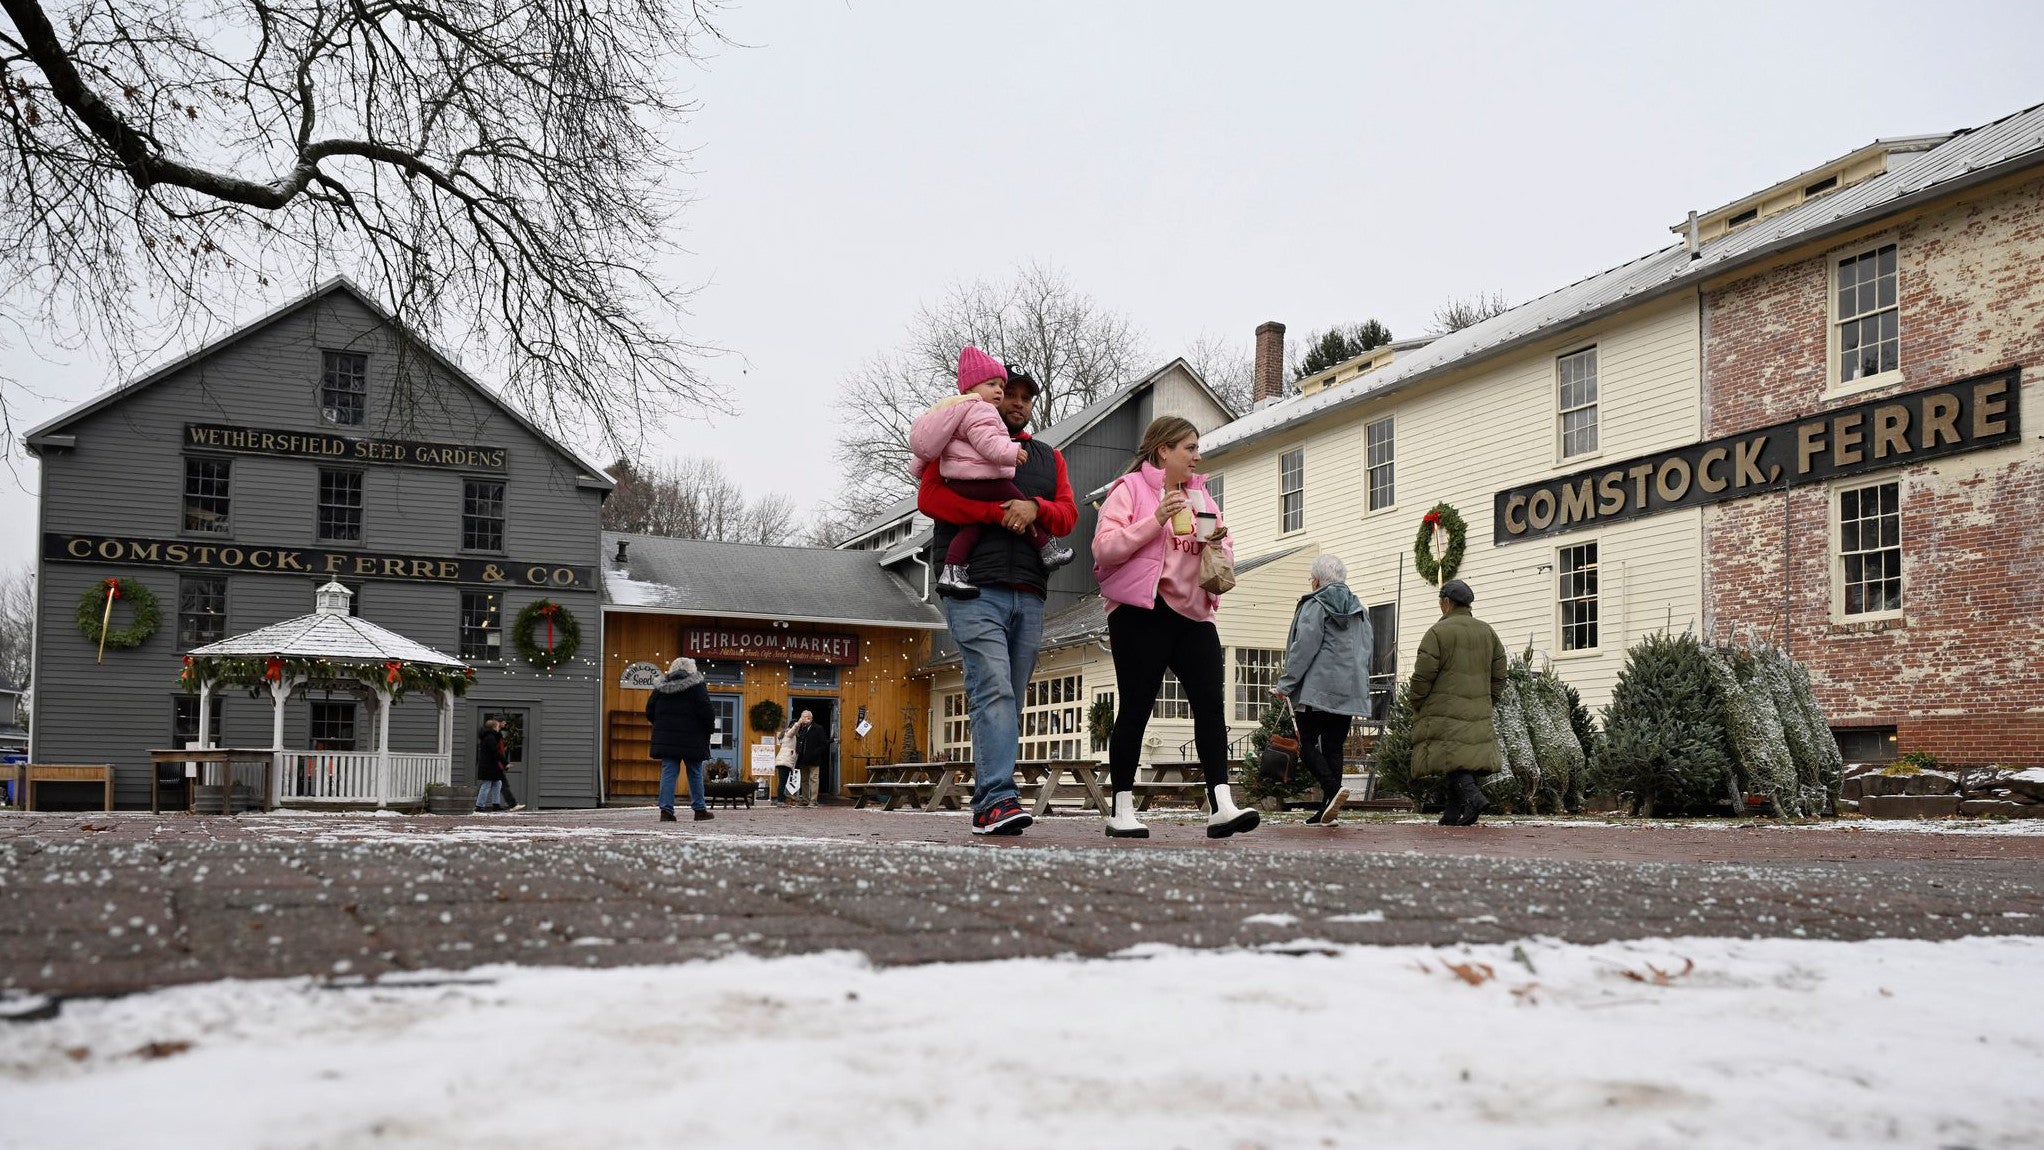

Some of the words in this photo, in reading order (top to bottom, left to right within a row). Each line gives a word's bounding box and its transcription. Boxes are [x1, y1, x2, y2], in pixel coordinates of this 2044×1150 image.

[189, 427, 344, 455] WETHERSFIELD
[354, 441, 406, 461] SEED
[415, 446, 505, 468] GARDENS
[1504, 435, 1781, 535] COMSTOCK,
[1798, 379, 2007, 475] FERRE
[67, 539, 312, 573] COMSTOCK,
[324, 553, 460, 579] FERRE
[481, 563, 506, 582] &
[526, 566, 580, 586] CO.
[1172, 538, 1202, 555] POU
[690, 631, 778, 651] HEIRLOOM
[786, 636, 851, 658] MARKET
[632, 674, 655, 686] Seed
